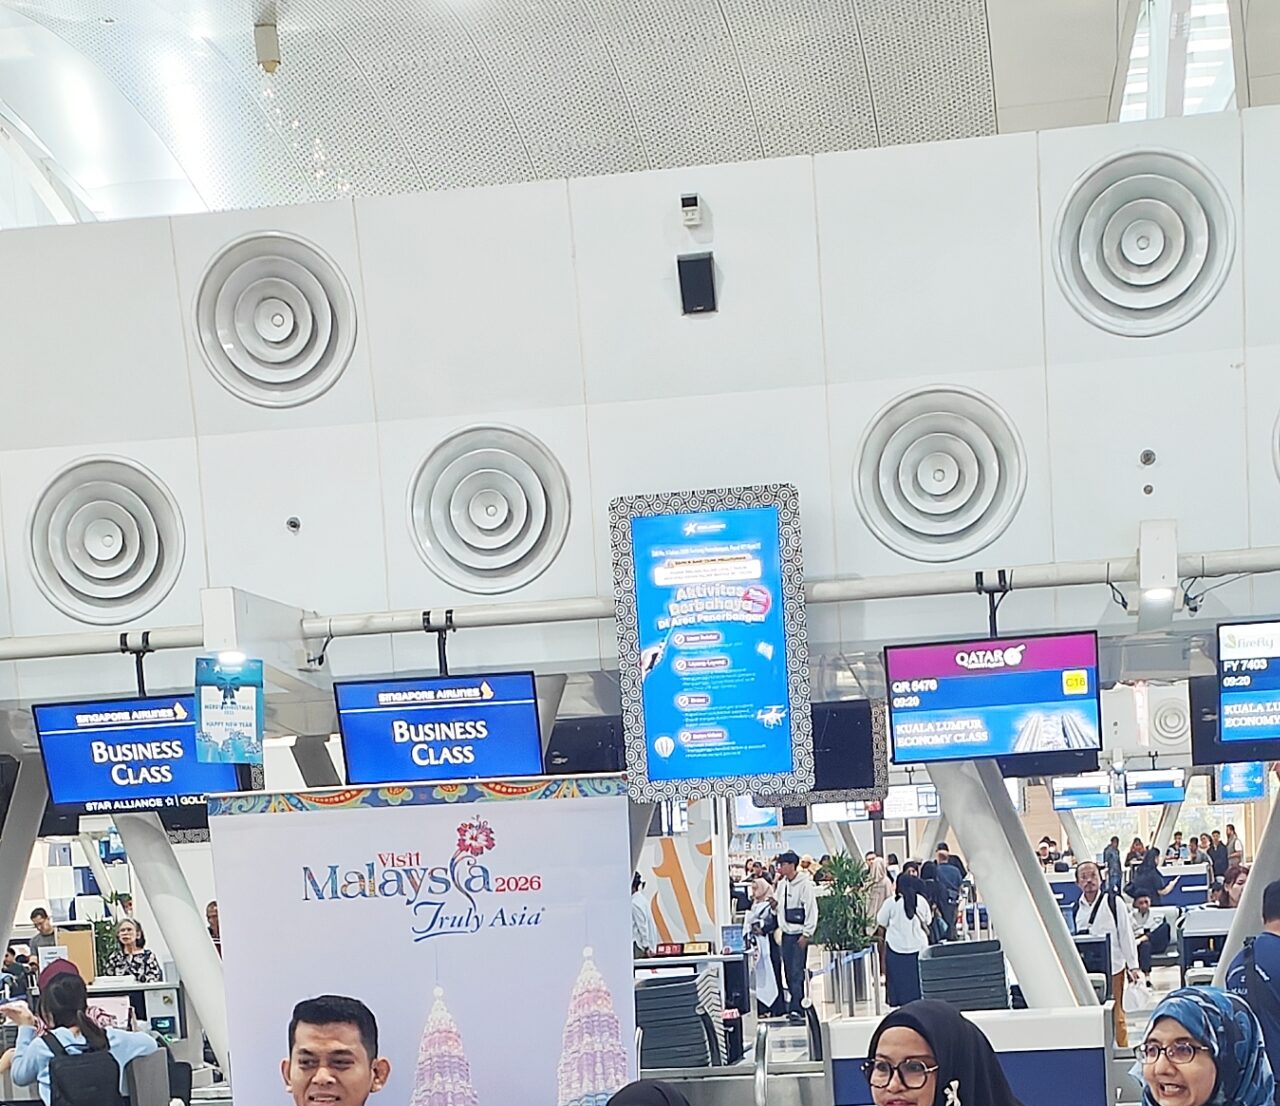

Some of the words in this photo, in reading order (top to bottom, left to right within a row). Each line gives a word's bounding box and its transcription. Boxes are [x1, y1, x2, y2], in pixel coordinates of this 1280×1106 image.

[955, 649, 1005, 667] QATAR
[1223, 659, 1239, 672] FY
[1224, 703, 1266, 715] KUALA
[393, 719, 489, 744] BUSINESS
[896, 721, 934, 735] KUALA
[935, 718, 983, 732] LUMPUR
[896, 734, 952, 748] ECONOMY
[953, 731, 989, 744] CLASS
[91, 739, 185, 764] BUSINESS
[411, 743, 476, 766] CLASS
[111, 763, 173, 786] CLASS
[85, 800, 113, 812] STAR
[114, 797, 164, 810] ALLIANCE
[377, 851, 422, 869] Visit
[302, 855, 494, 906] Malaysia
[495, 875, 542, 893] 2026
[411, 901, 484, 942] Truly
[488, 906, 543, 928] Asia
